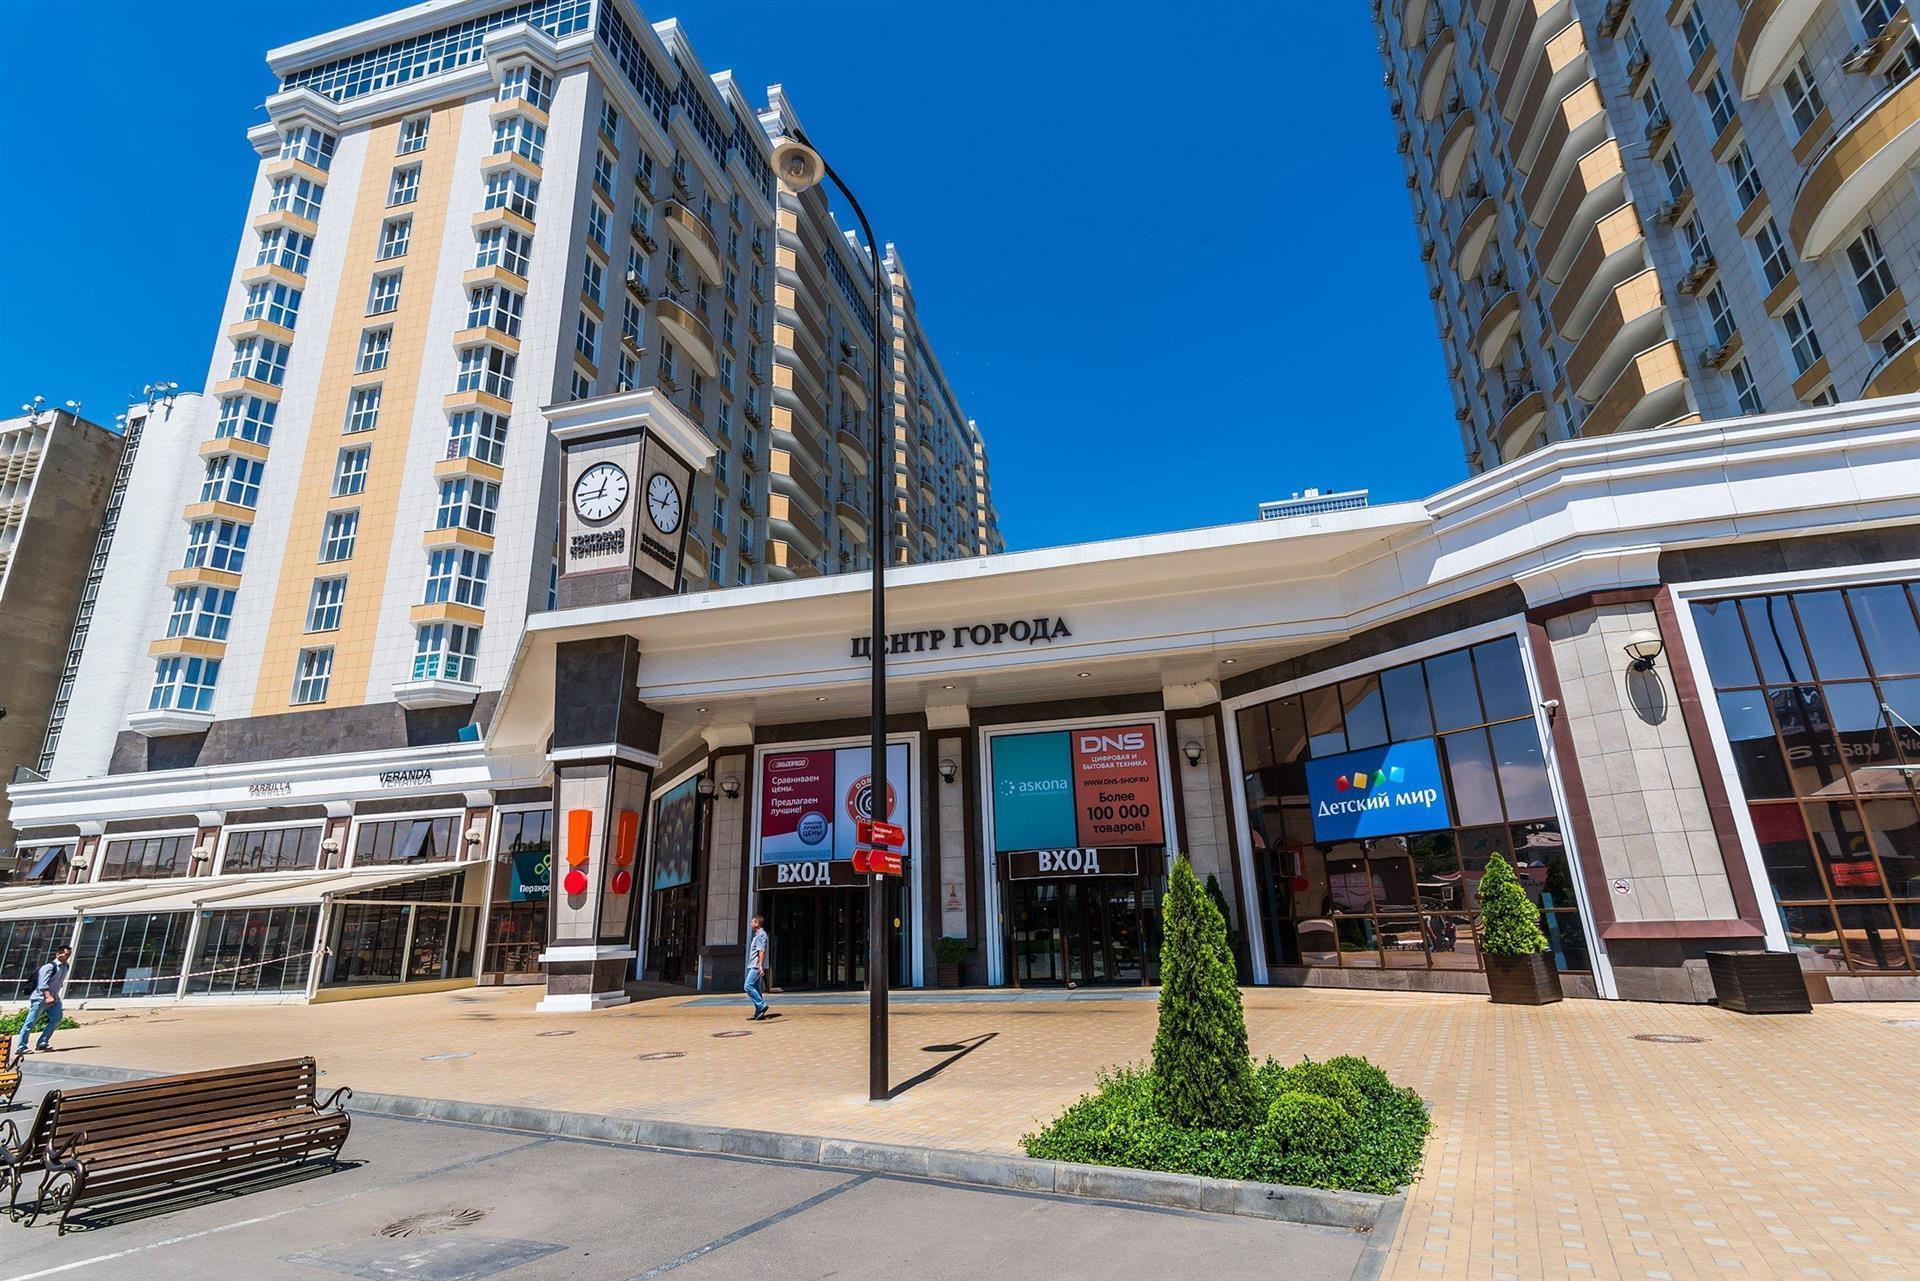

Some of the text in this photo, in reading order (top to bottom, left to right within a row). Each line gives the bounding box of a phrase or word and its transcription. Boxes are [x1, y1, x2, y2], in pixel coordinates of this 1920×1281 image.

[571, 528, 625, 545] ТОРГОВЫЙ
[953, 616, 1072, 648] ГОРОДА
[1081, 732, 1145, 753] DNS
[1083, 760, 1147, 770] БЫТОВАЯ ТЕХНИКА
[1091, 754, 1130, 763] ЦИФРОВАЯ
[379, 769, 431, 782] VERANDA
[772, 775, 820, 785] Сравниваем
[1083, 776, 1149, 787] WWW.DNS-SHOP.RU
[249, 782, 291, 793] PARRILLA
[1019, 779, 1068, 792] askona
[771, 797, 818, 807] Предлагаем
[1099, 792, 1135, 803] Более
[1318, 788, 1437, 817] Детский мир
[770, 806, 802, 817] лучшие!
[1087, 803, 1150, 821] 100 000
[1092, 821, 1146, 835] товаров!
[1038, 848, 1100, 873] ВХОД
[777, 861, 831, 885] ВХОД
